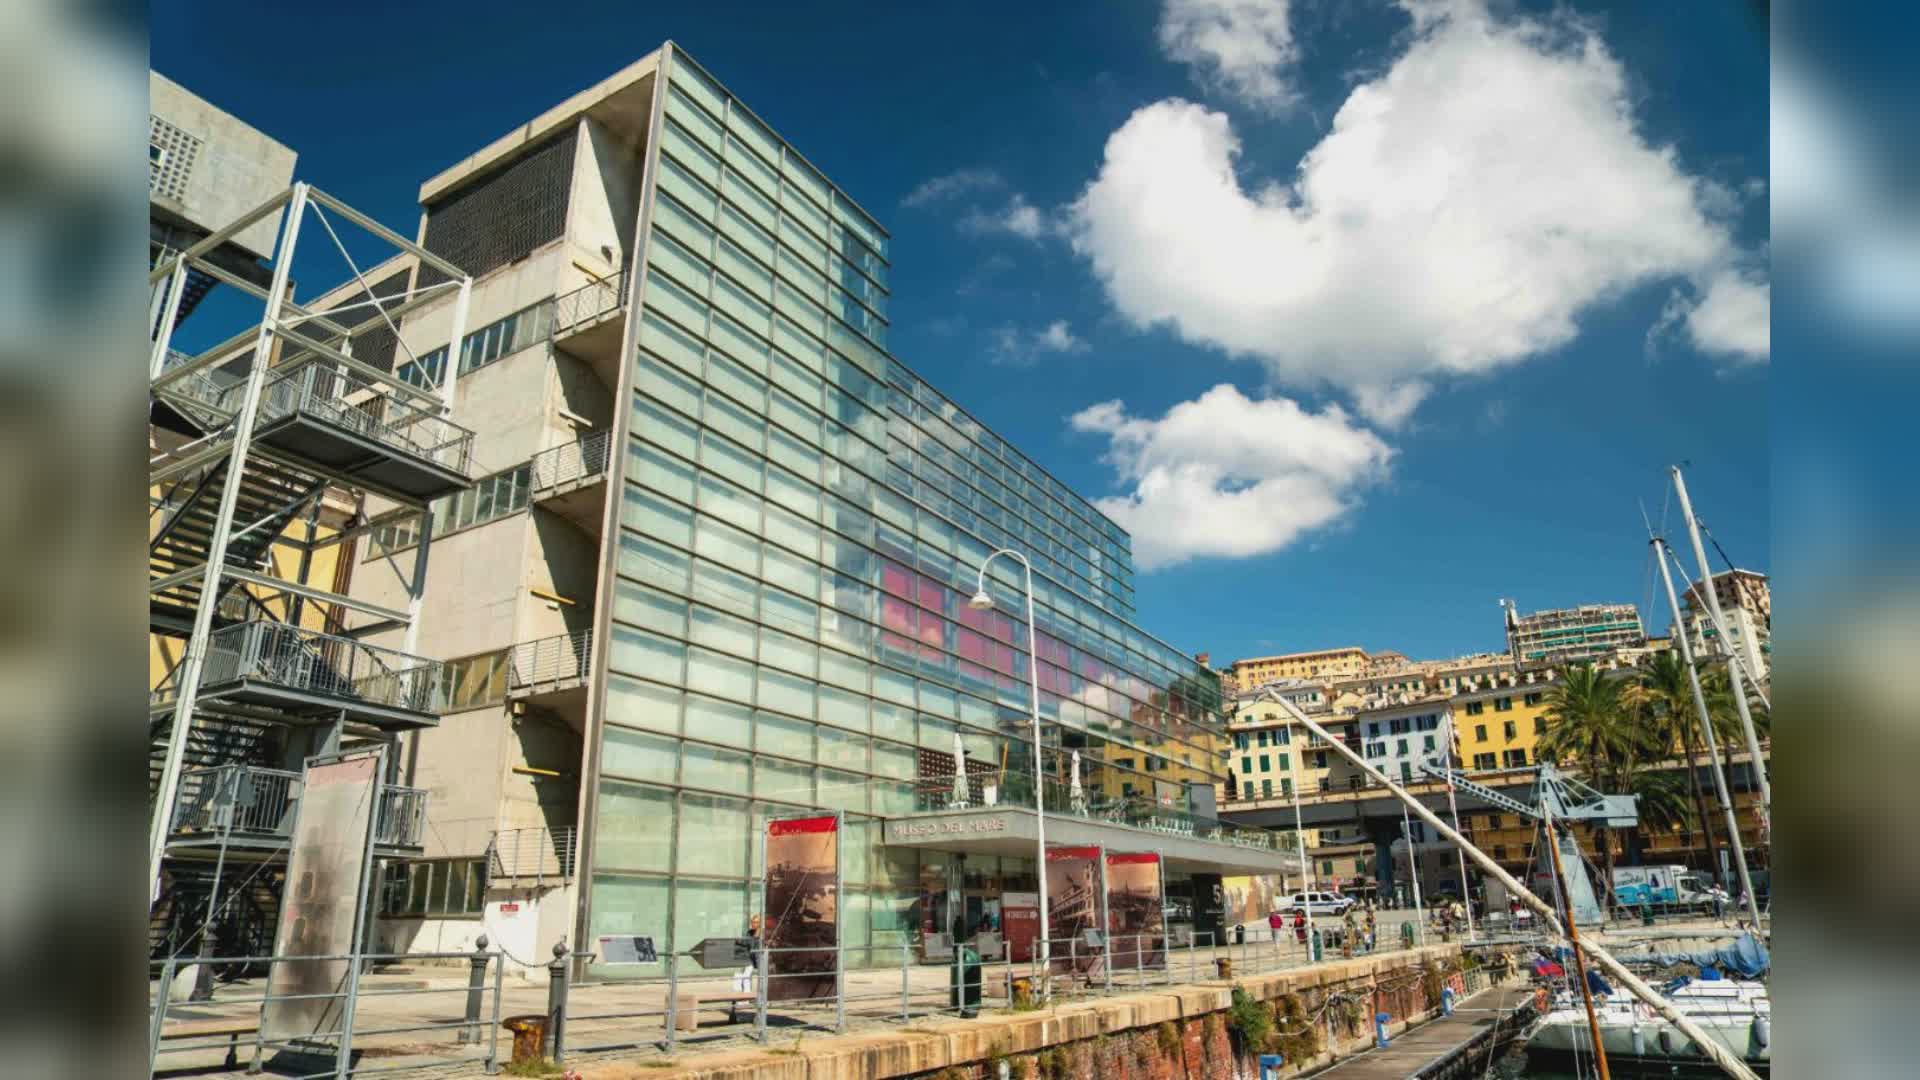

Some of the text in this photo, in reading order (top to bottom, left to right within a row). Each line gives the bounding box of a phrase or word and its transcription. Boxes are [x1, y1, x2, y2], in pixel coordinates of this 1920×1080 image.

[895, 816, 1006, 838] MUSEO DEL MARE
